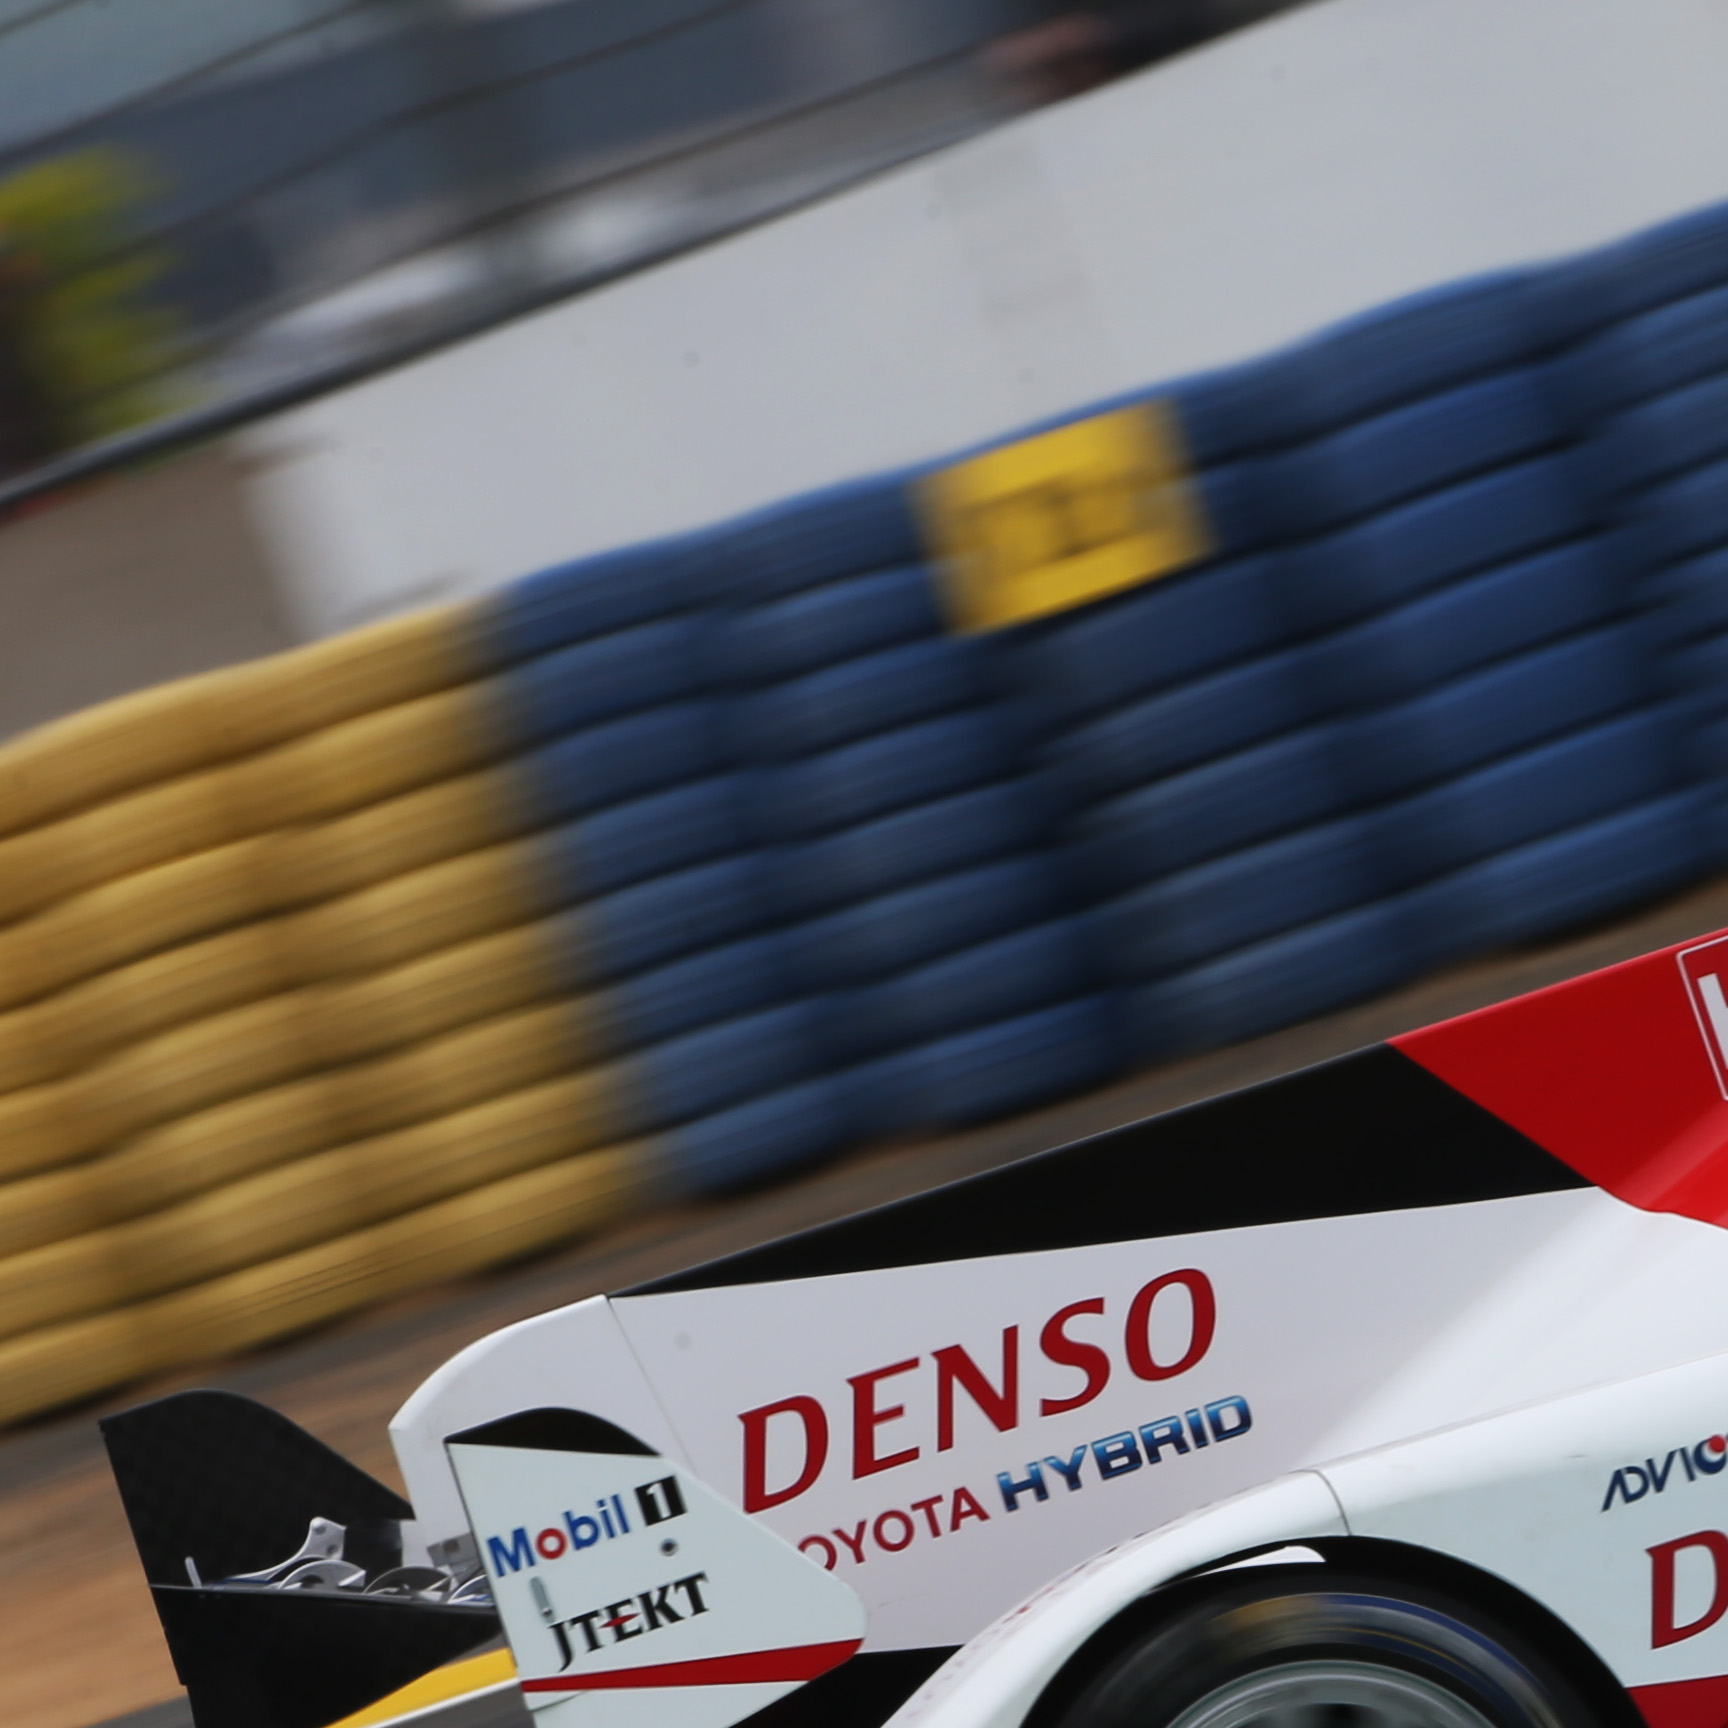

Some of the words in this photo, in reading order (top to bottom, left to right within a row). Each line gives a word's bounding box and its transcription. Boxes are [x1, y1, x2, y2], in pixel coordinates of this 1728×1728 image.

[738, 1268, 1216, 1515] DENSO
[486, 1493, 631, 1578] Mobil
[638, 1474, 686, 1527] 1
[799, 1485, 990, 1572] OYOTA
[997, 1395, 1252, 1513] HYBRID
[547, 1573, 710, 1673] JTEKT
